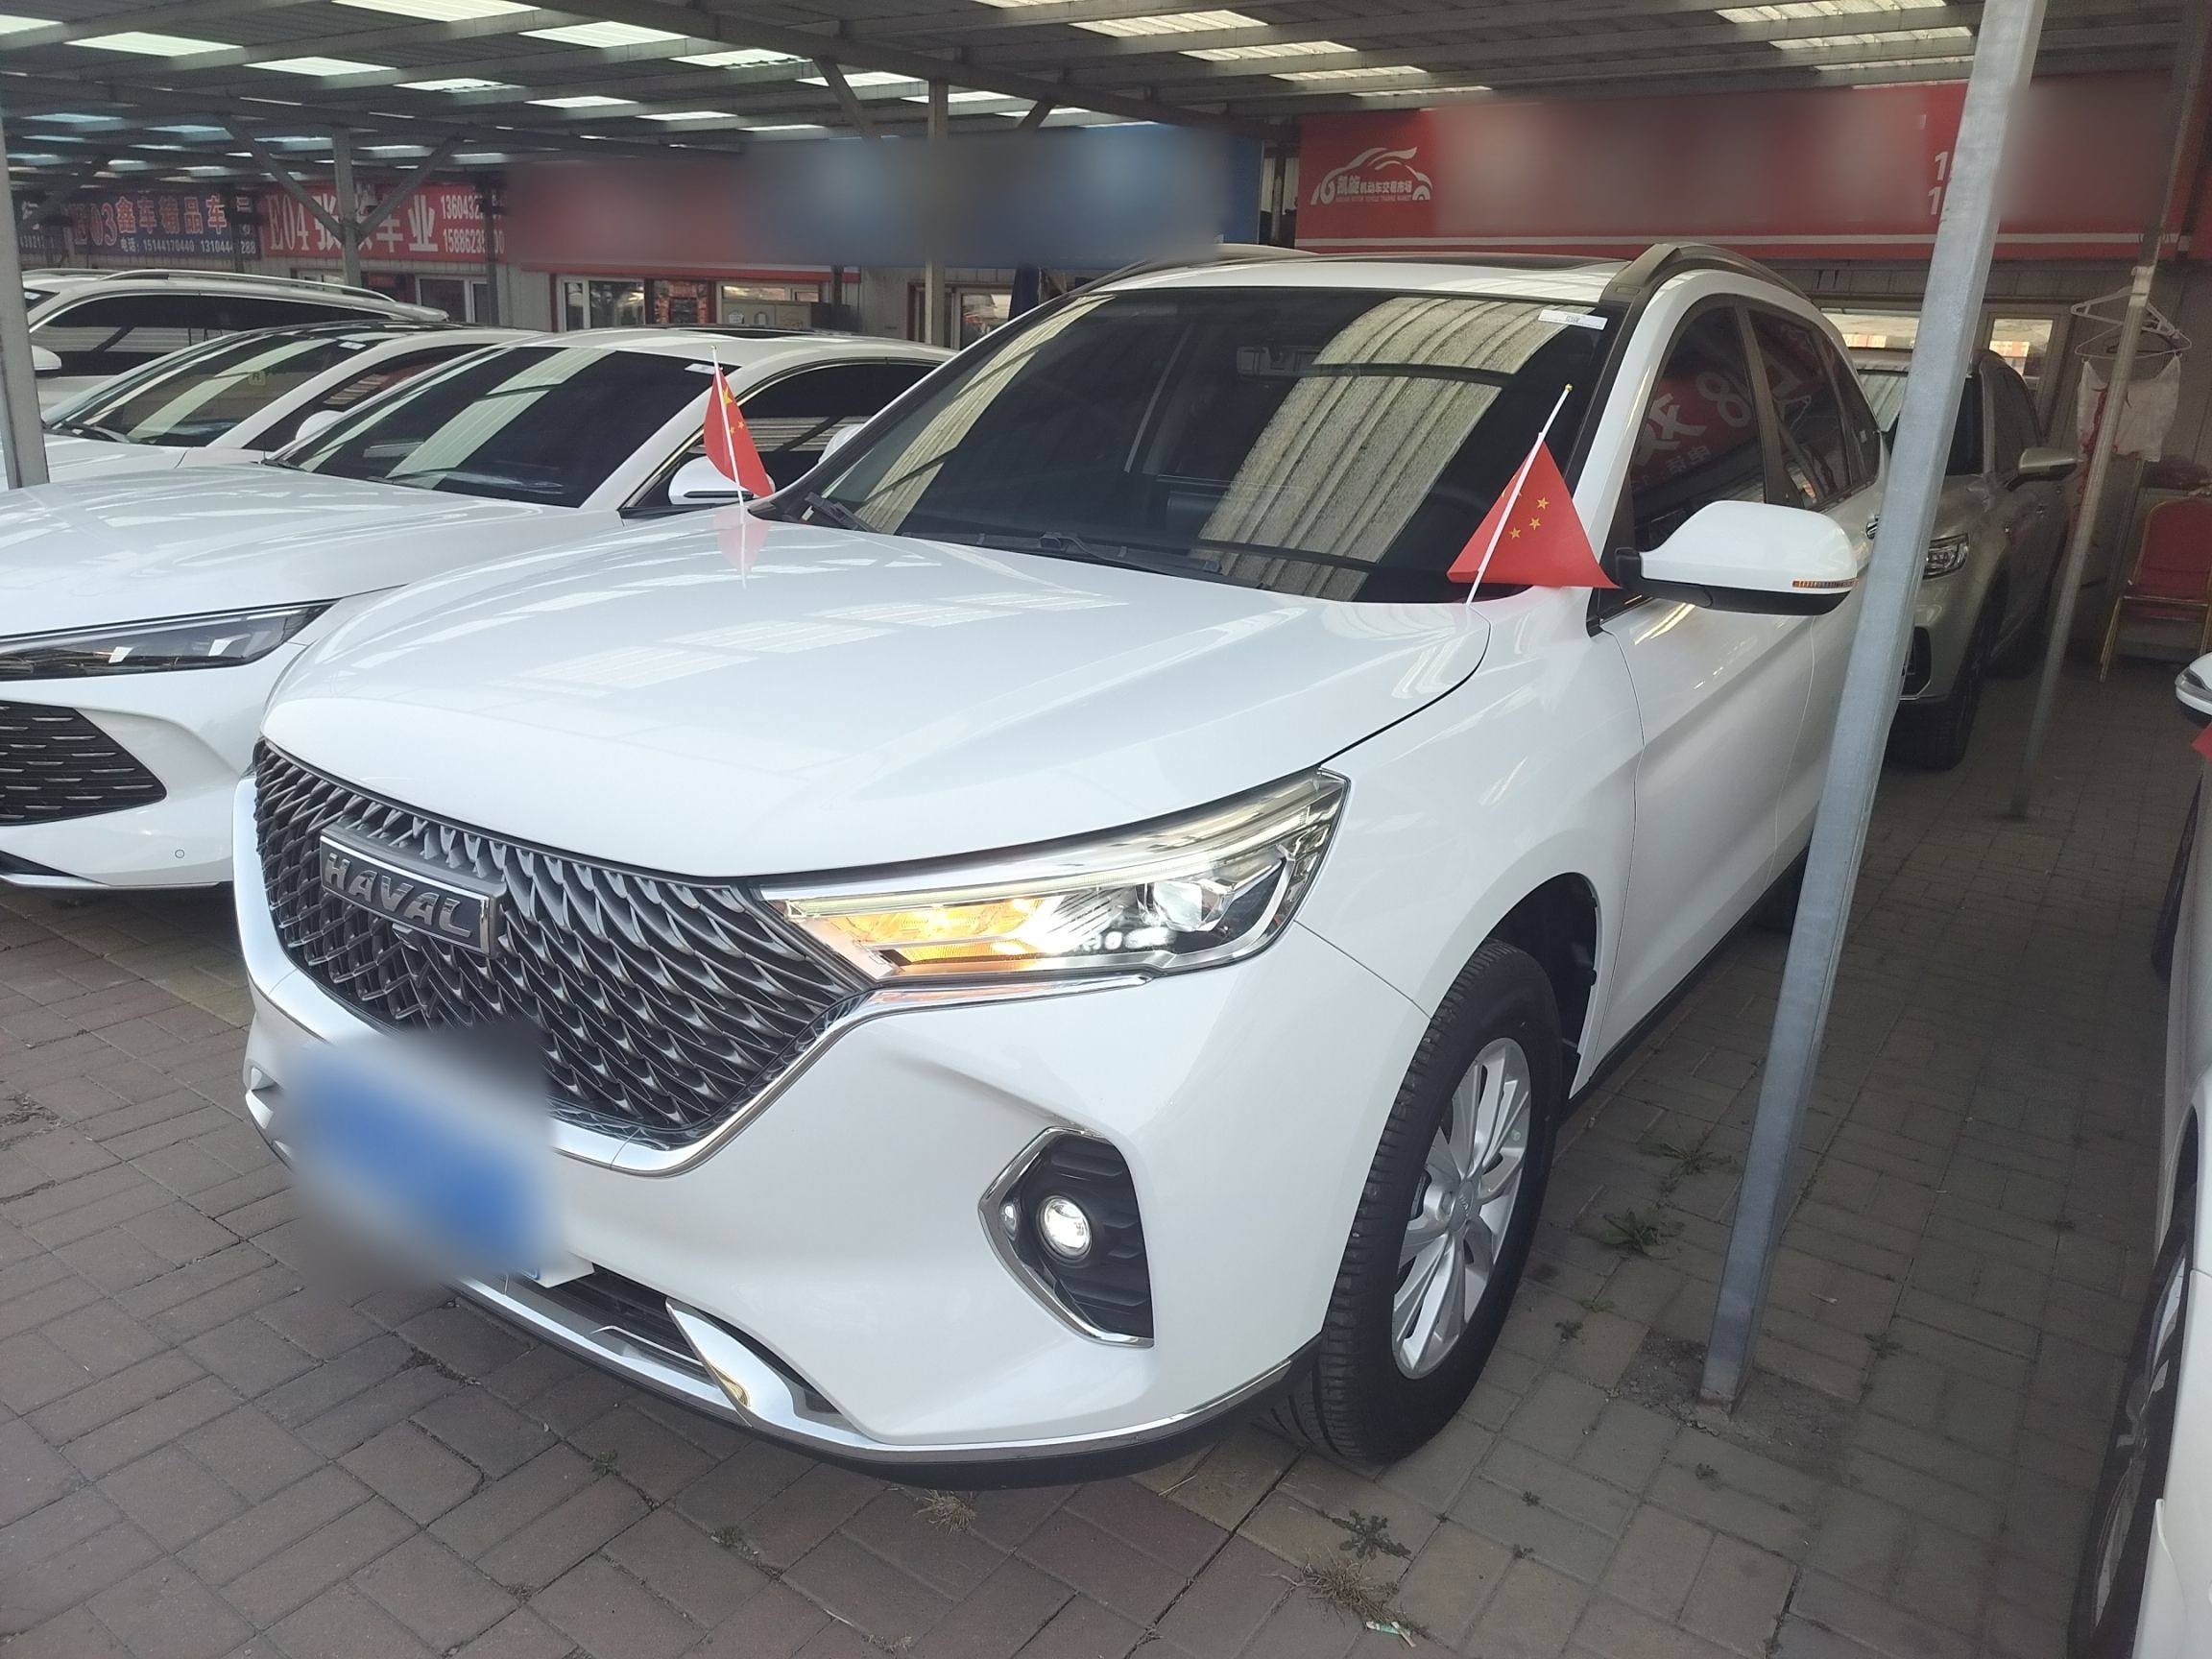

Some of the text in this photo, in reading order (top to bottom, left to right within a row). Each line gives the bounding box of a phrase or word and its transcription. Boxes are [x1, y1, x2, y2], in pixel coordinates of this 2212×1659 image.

[200, 239, 256, 254] 131044288
[312, 191, 439, 253] 张车业
[323, 853, 471, 938] HAVAL
